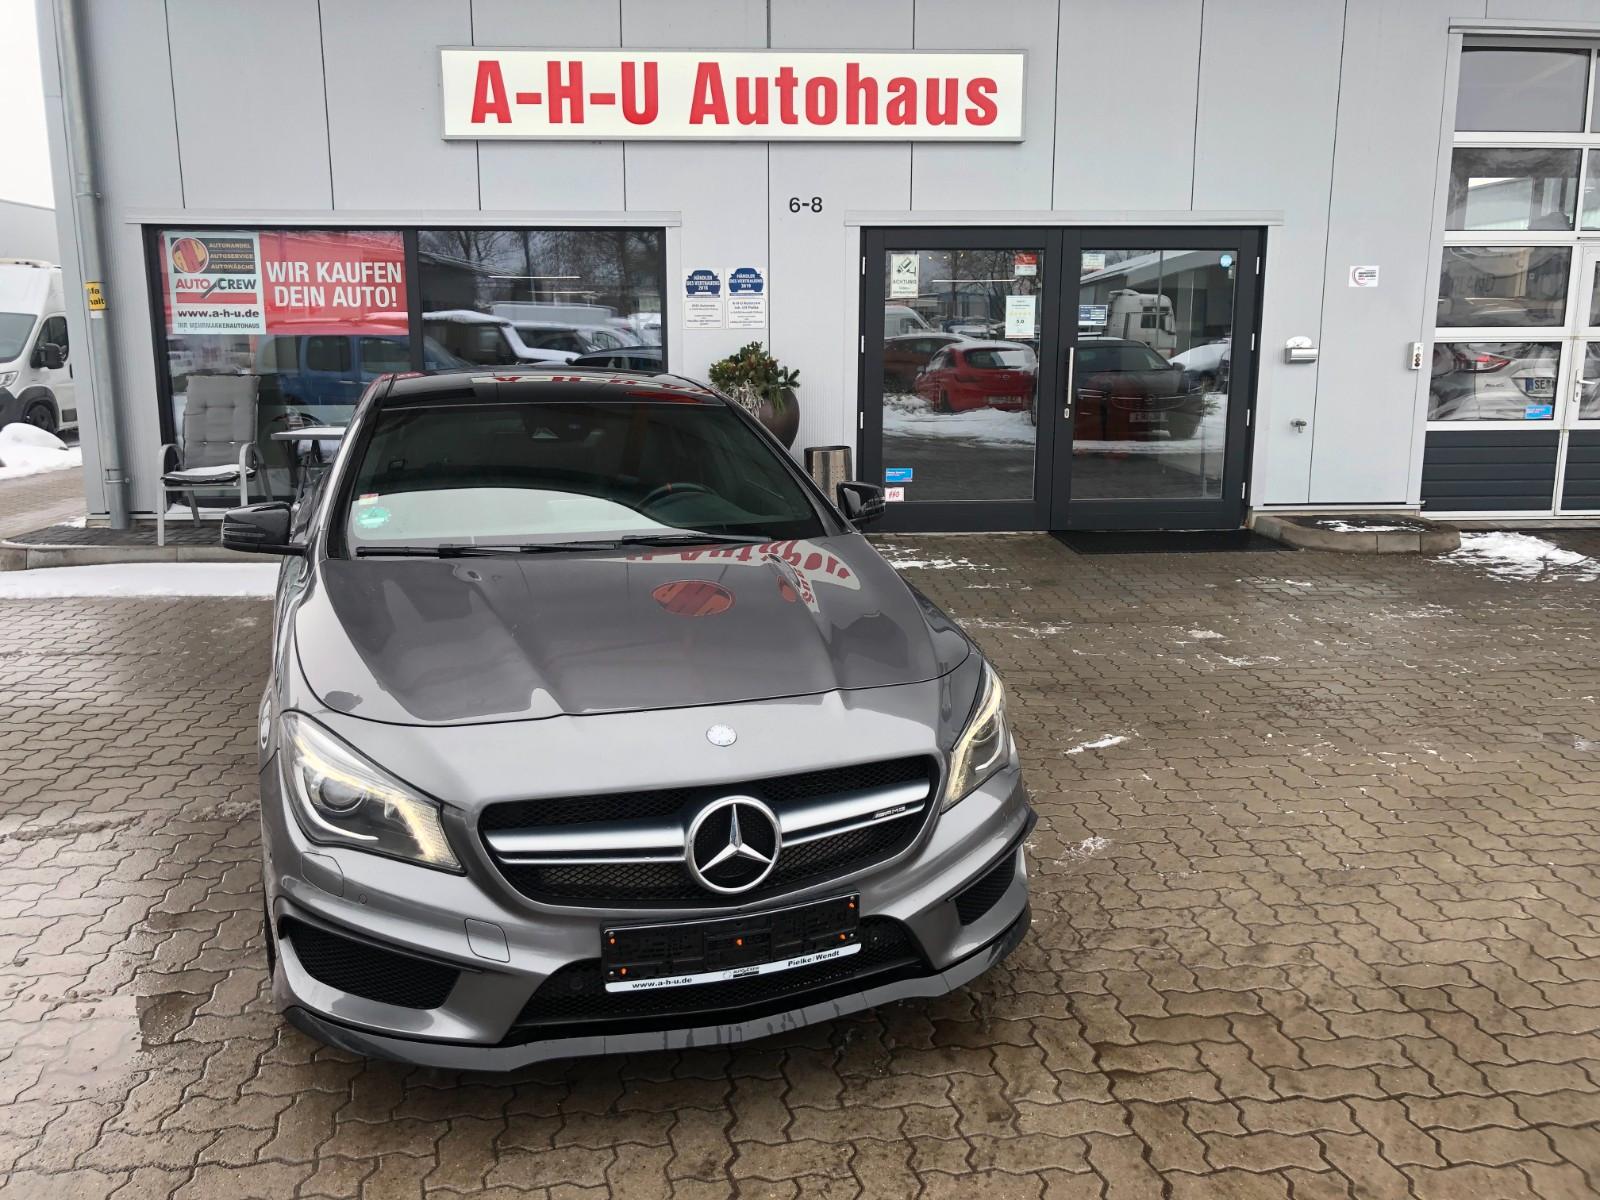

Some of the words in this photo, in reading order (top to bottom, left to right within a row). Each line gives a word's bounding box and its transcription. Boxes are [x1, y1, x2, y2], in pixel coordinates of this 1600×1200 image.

[471, 60, 659, 126] A-H-U
[690, 61, 998, 127] Autohaus
[789, 196, 823, 213] 6-8
[266, 261, 309, 283] WIR
[316, 261, 402, 283] KAUFEN
[274, 286, 326, 307] DEIN
[332, 286, 397, 308] AUTO!
[177, 308, 260, 318] www.a-h-u.de
[632, 977, 693, 989] www.a-h-u.de
